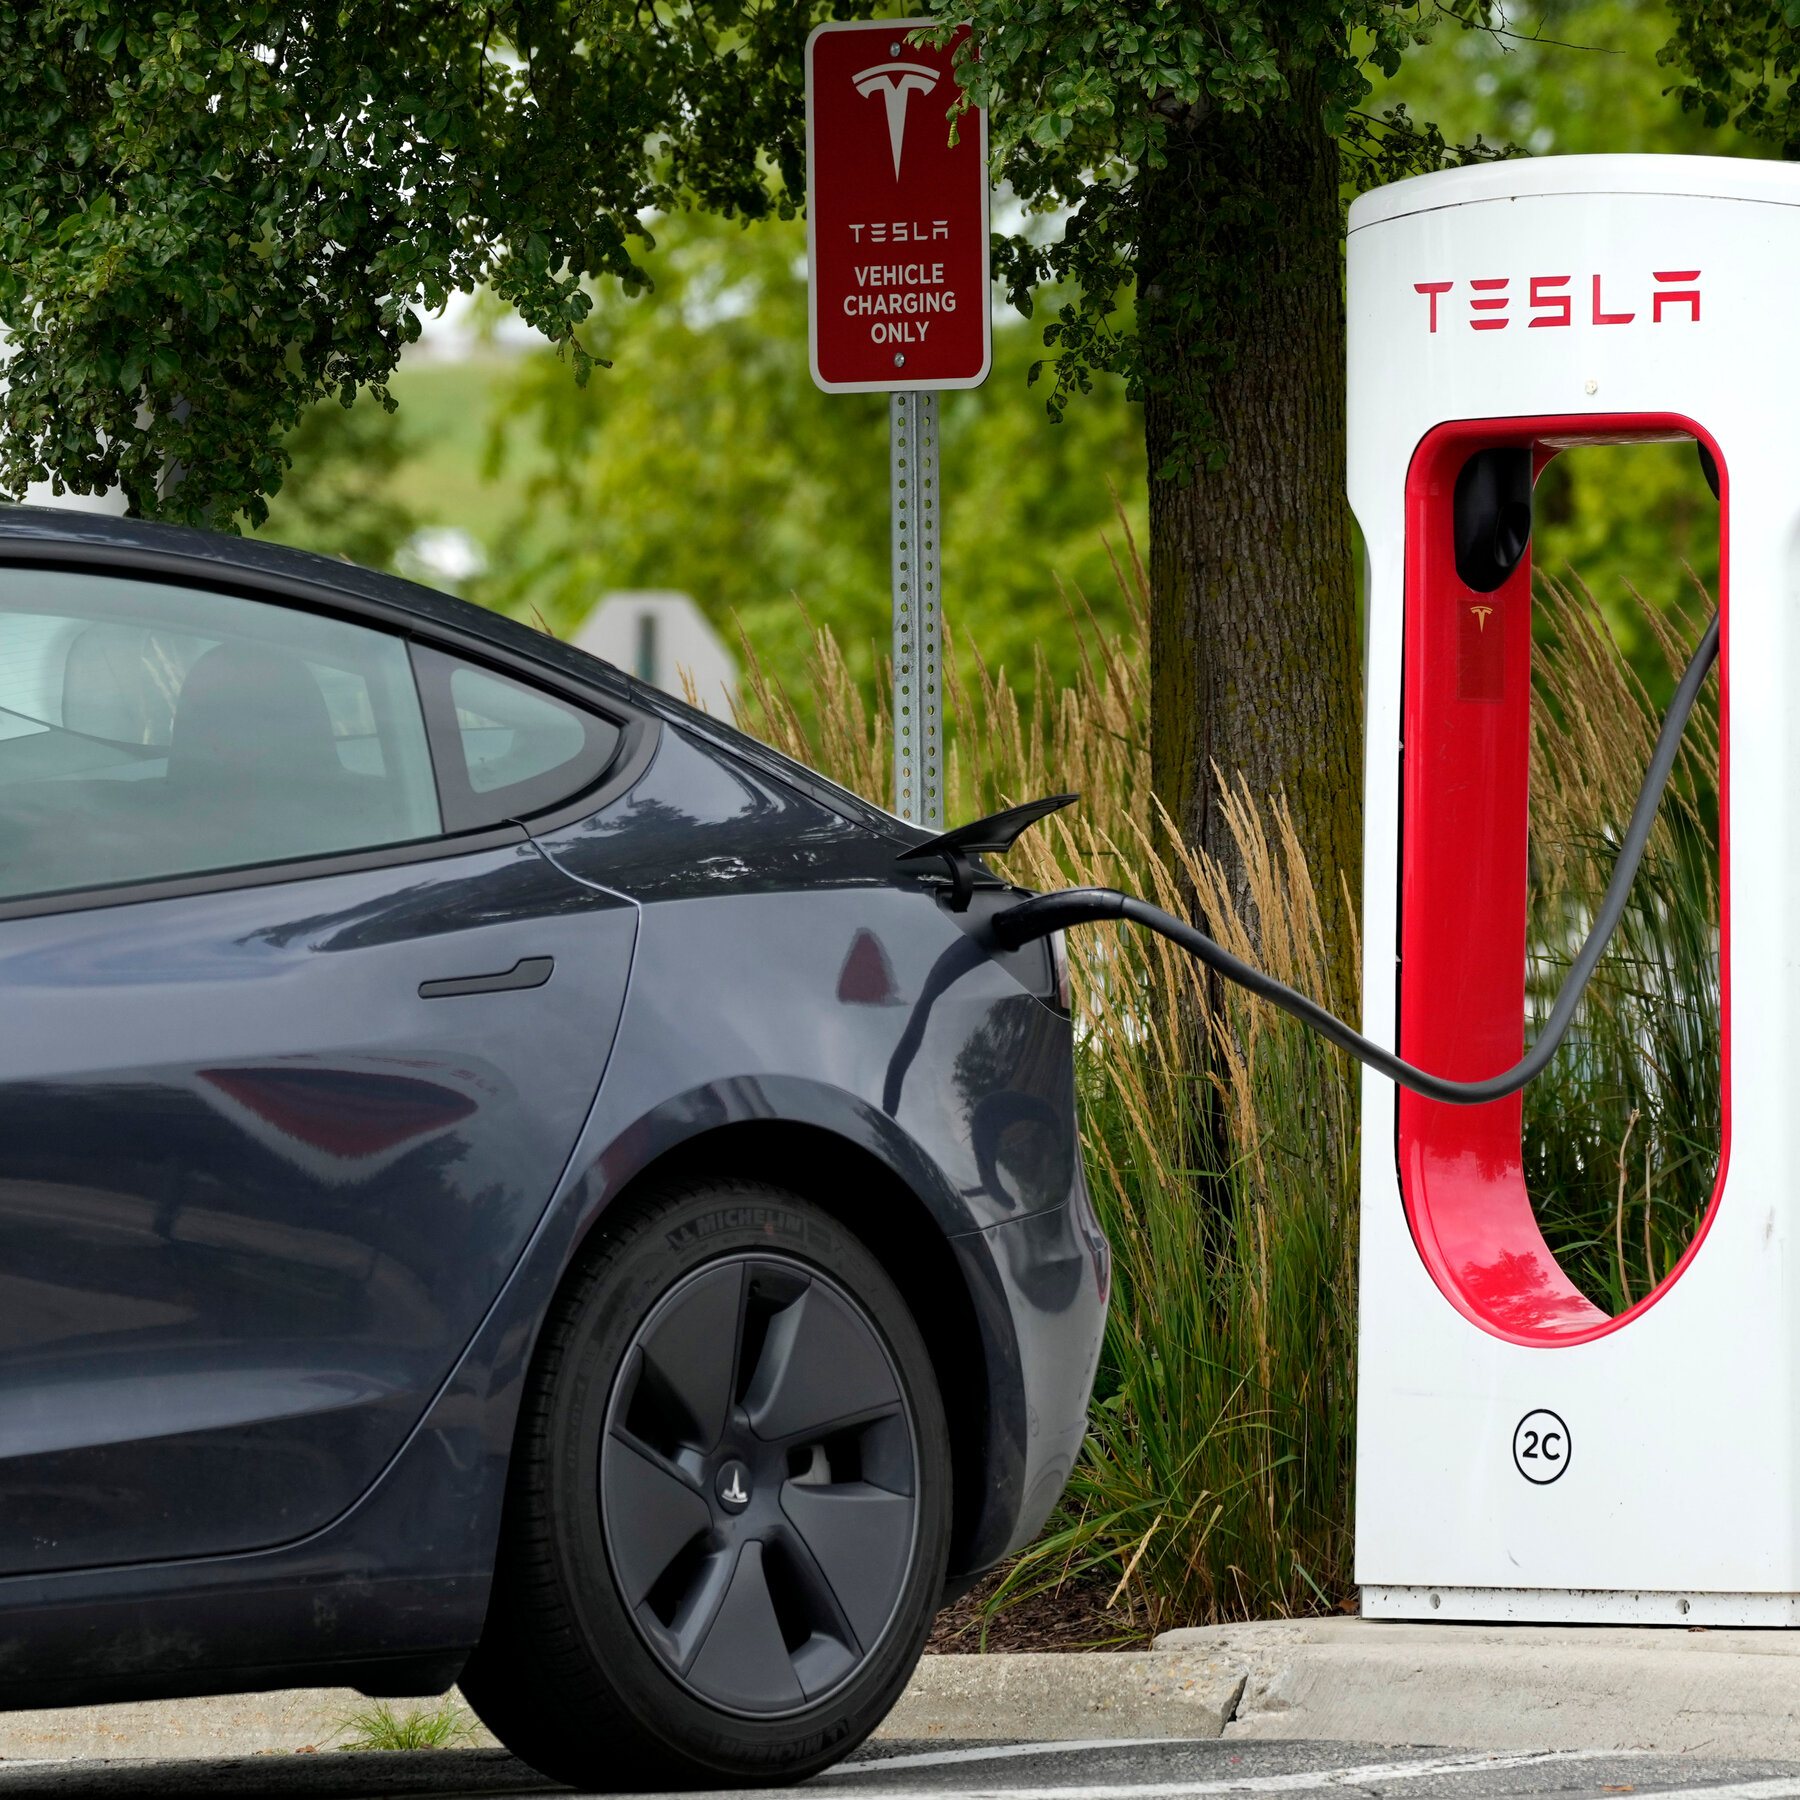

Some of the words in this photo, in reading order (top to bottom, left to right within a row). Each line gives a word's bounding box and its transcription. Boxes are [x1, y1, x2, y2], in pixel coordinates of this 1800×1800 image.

[849, 221, 948, 243] TESLA
[854, 263, 944, 287] VEHICLE
[843, 291, 956, 316] CHARGING
[1413, 270, 1701, 333] TESLA
[871, 321, 929, 344] ONLY
[696, 1208, 801, 1236] MICHELIN
[1522, 1430, 1561, 1461] 2C
